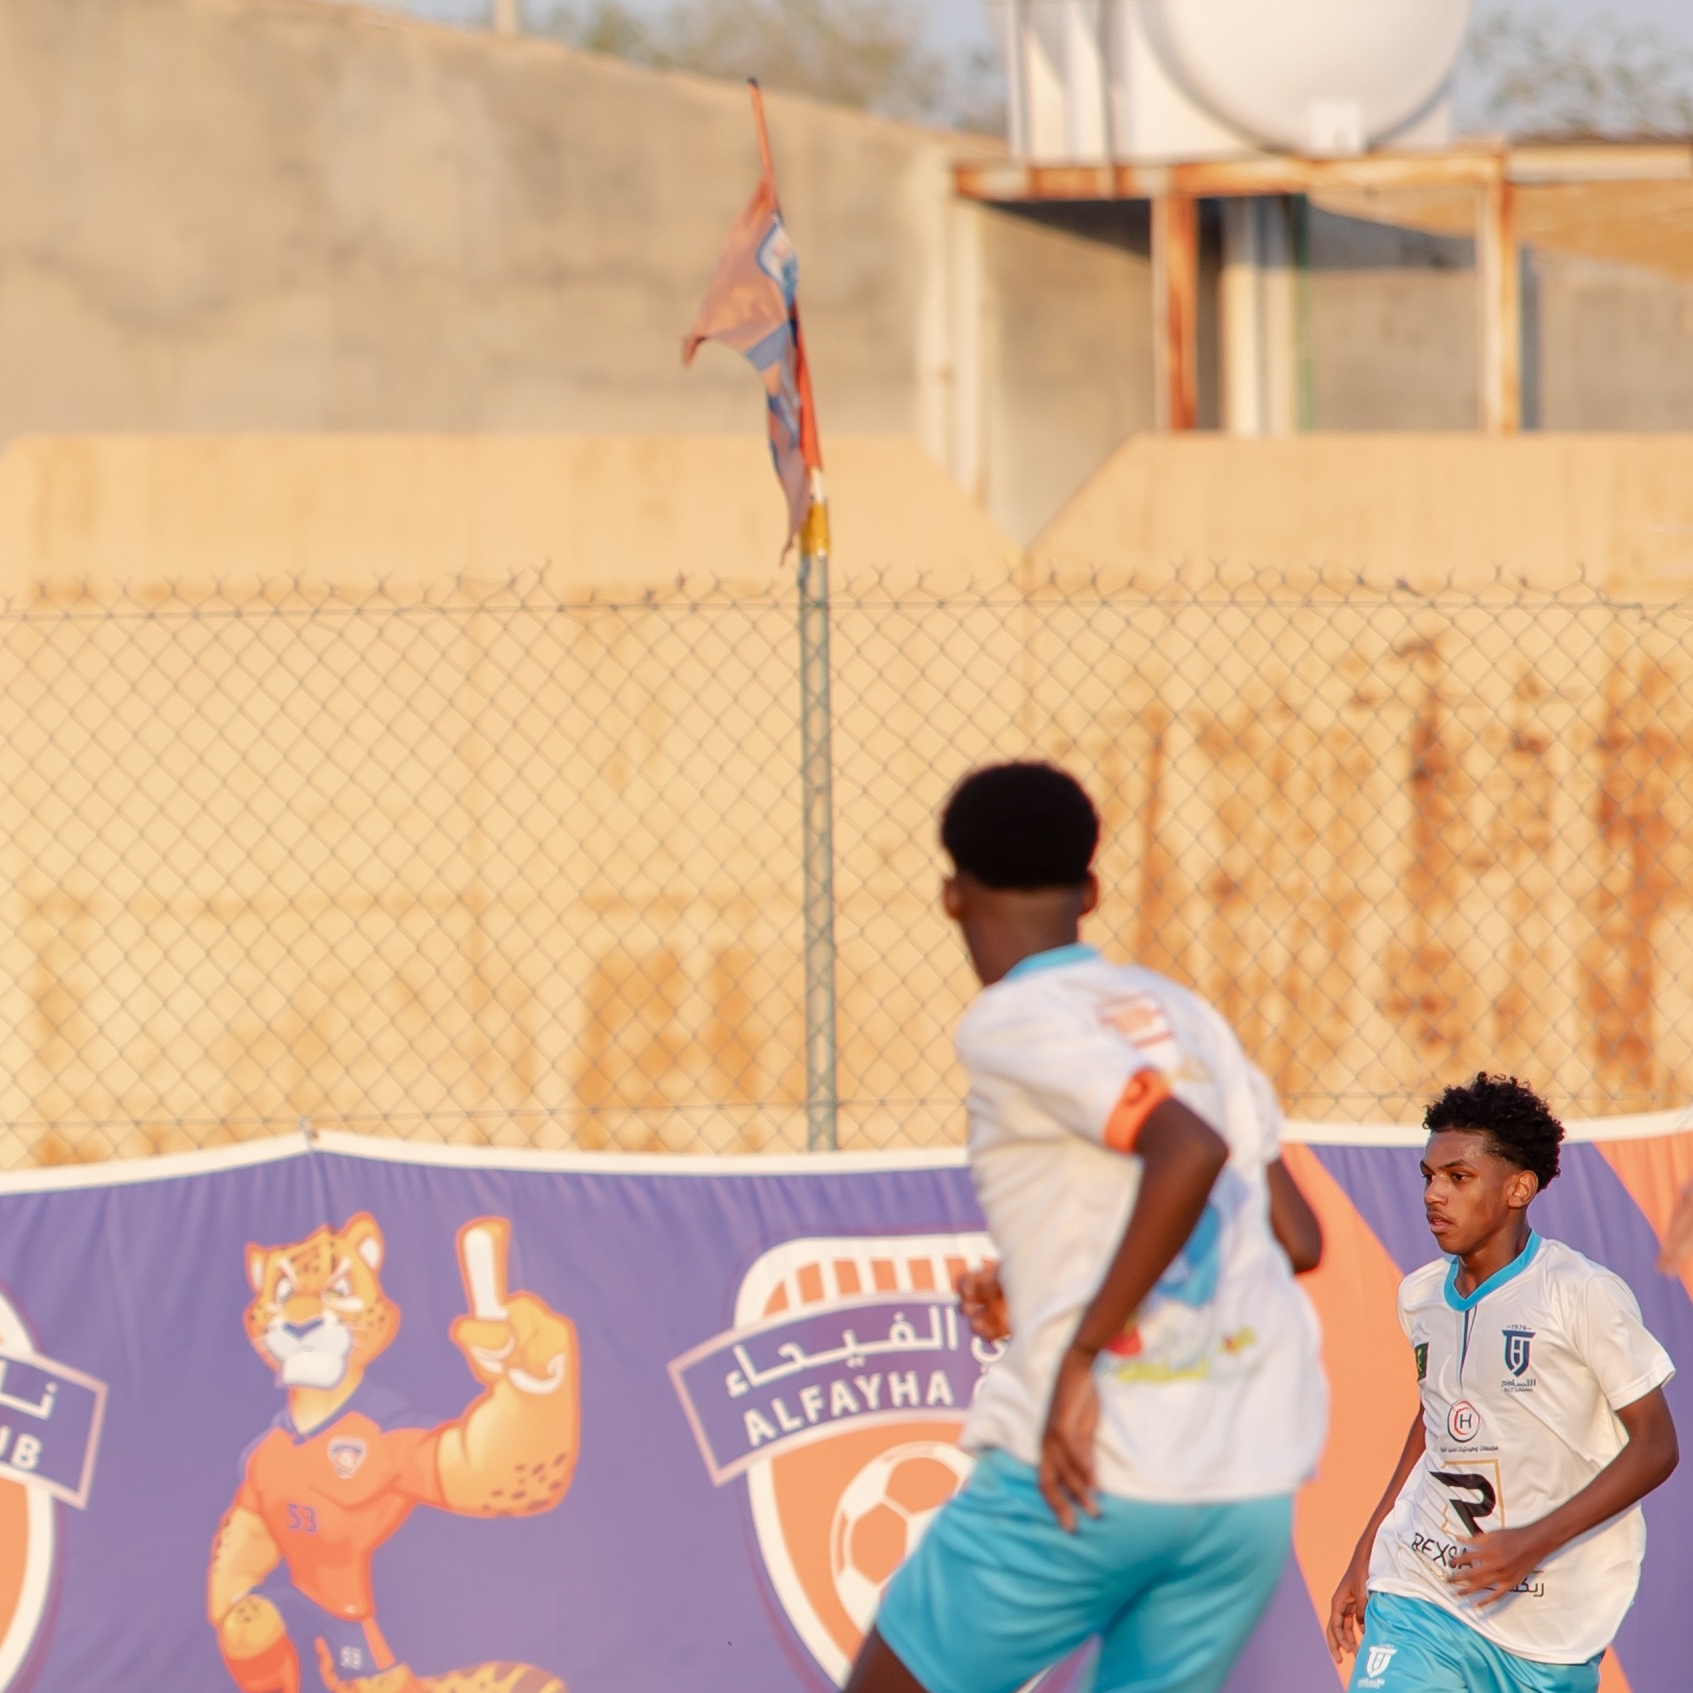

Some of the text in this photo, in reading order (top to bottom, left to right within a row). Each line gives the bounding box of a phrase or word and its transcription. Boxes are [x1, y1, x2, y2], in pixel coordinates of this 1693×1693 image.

[725, 1305, 959, 1399] الفيحاء
[744, 1369, 954, 1446] ALFAYHA
[288, 1503, 318, 1533] 53
